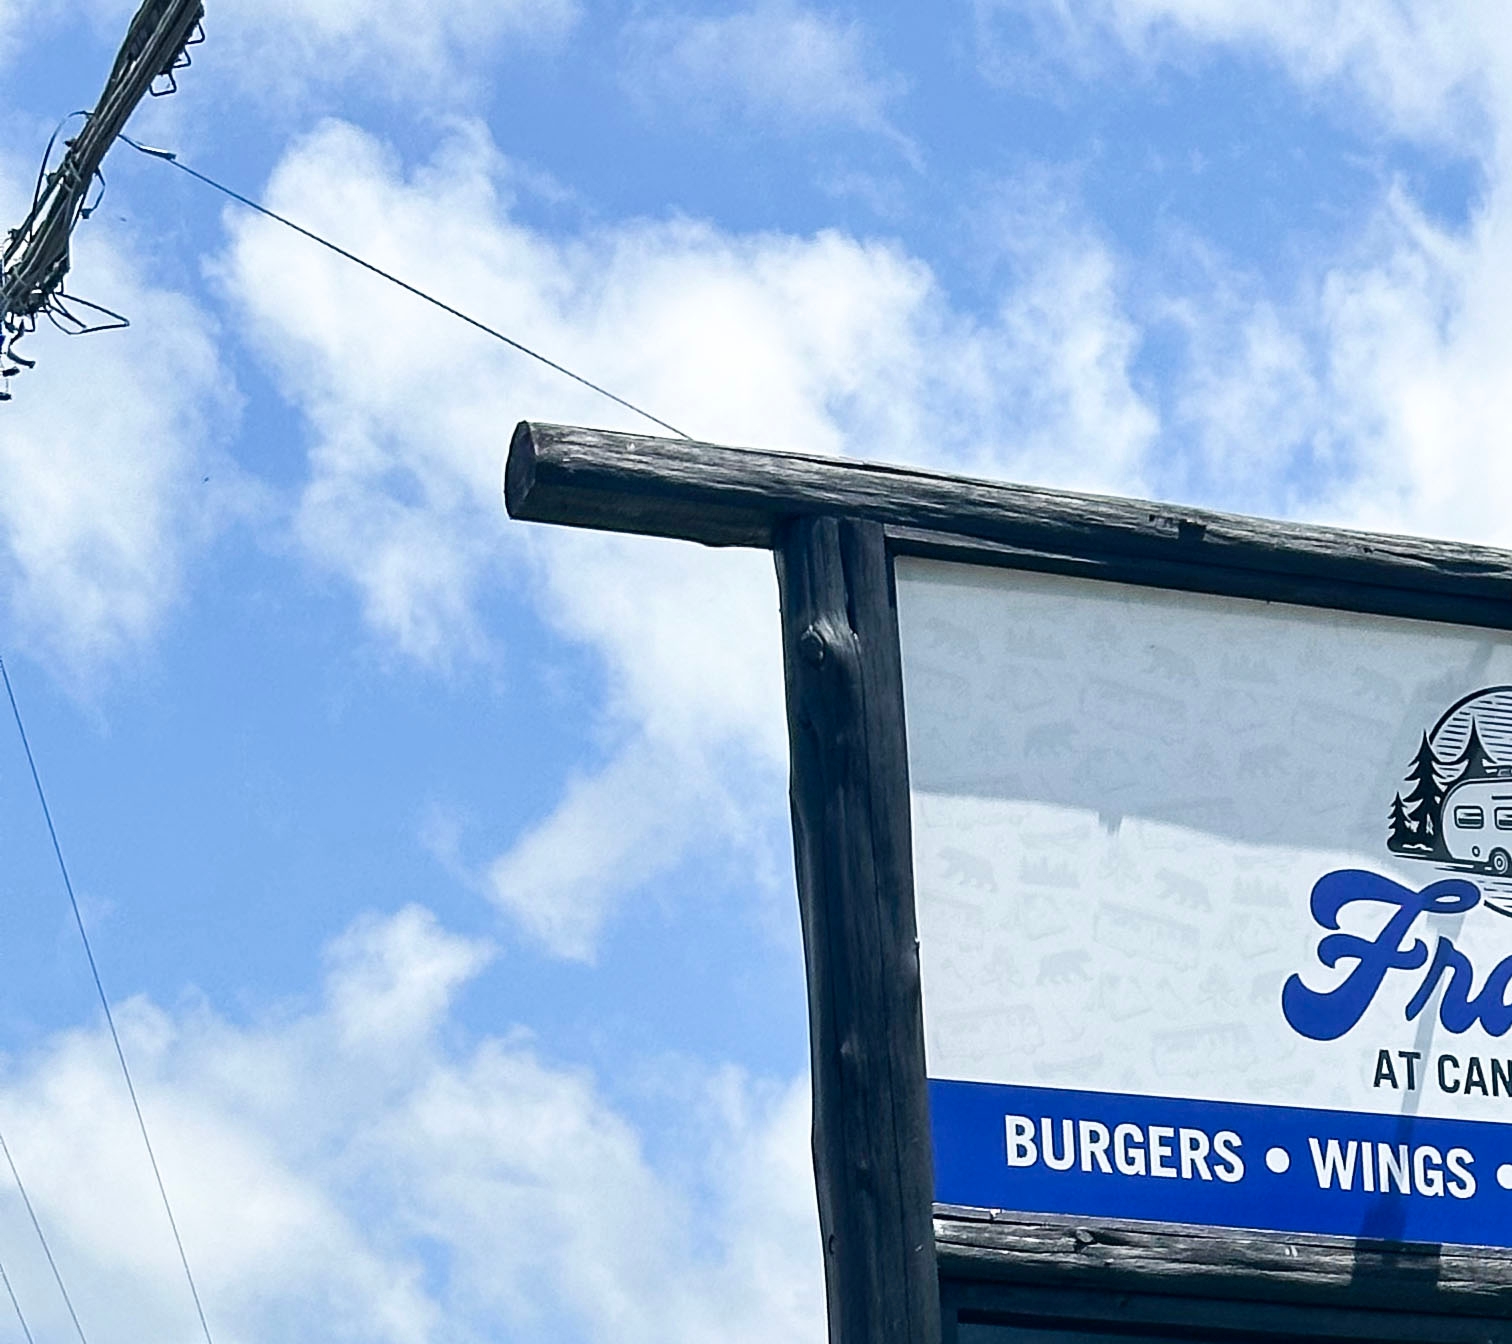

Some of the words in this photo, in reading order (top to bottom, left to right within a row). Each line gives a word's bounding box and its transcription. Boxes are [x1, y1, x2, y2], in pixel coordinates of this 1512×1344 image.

[1373, 1049, 1421, 1091] AT
[1005, 1114, 1244, 1183] BURGERS
[1308, 1137, 1476, 1199] WINGS
